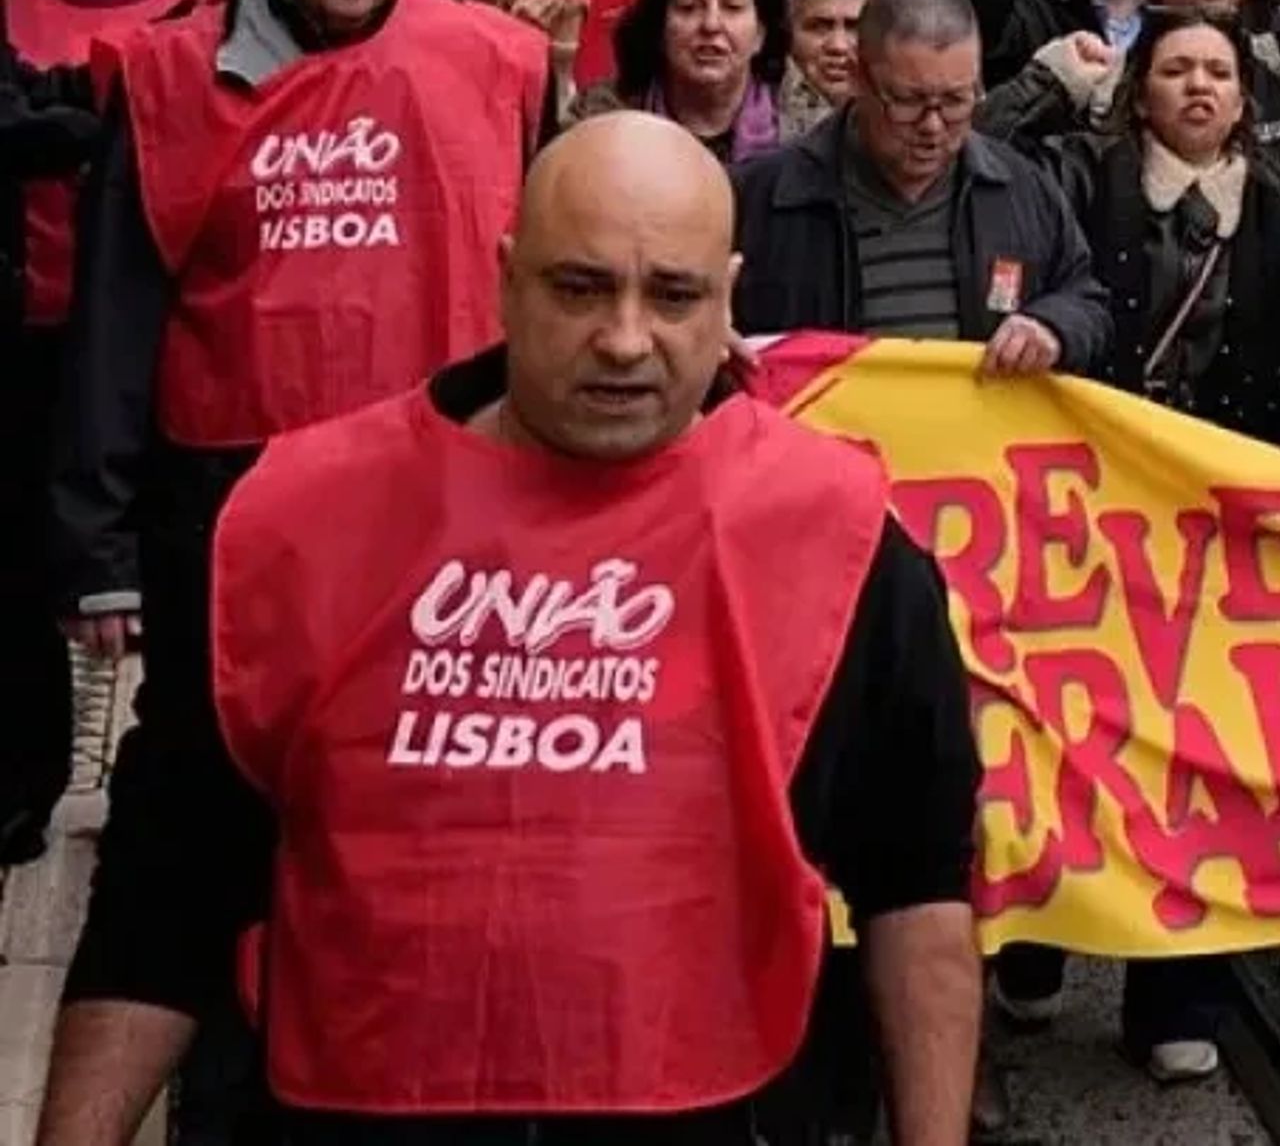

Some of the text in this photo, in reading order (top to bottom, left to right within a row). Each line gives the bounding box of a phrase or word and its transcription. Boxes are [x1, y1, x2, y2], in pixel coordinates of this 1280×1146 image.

[251, 116, 400, 177] UNIÃO
[256, 176, 397, 212] DOS SINDICATOS
[410, 557, 676, 654] UNIÃO
[403, 650, 660, 704] DOS SINDICATOS
[386, 710, 648, 775] LISBOA
